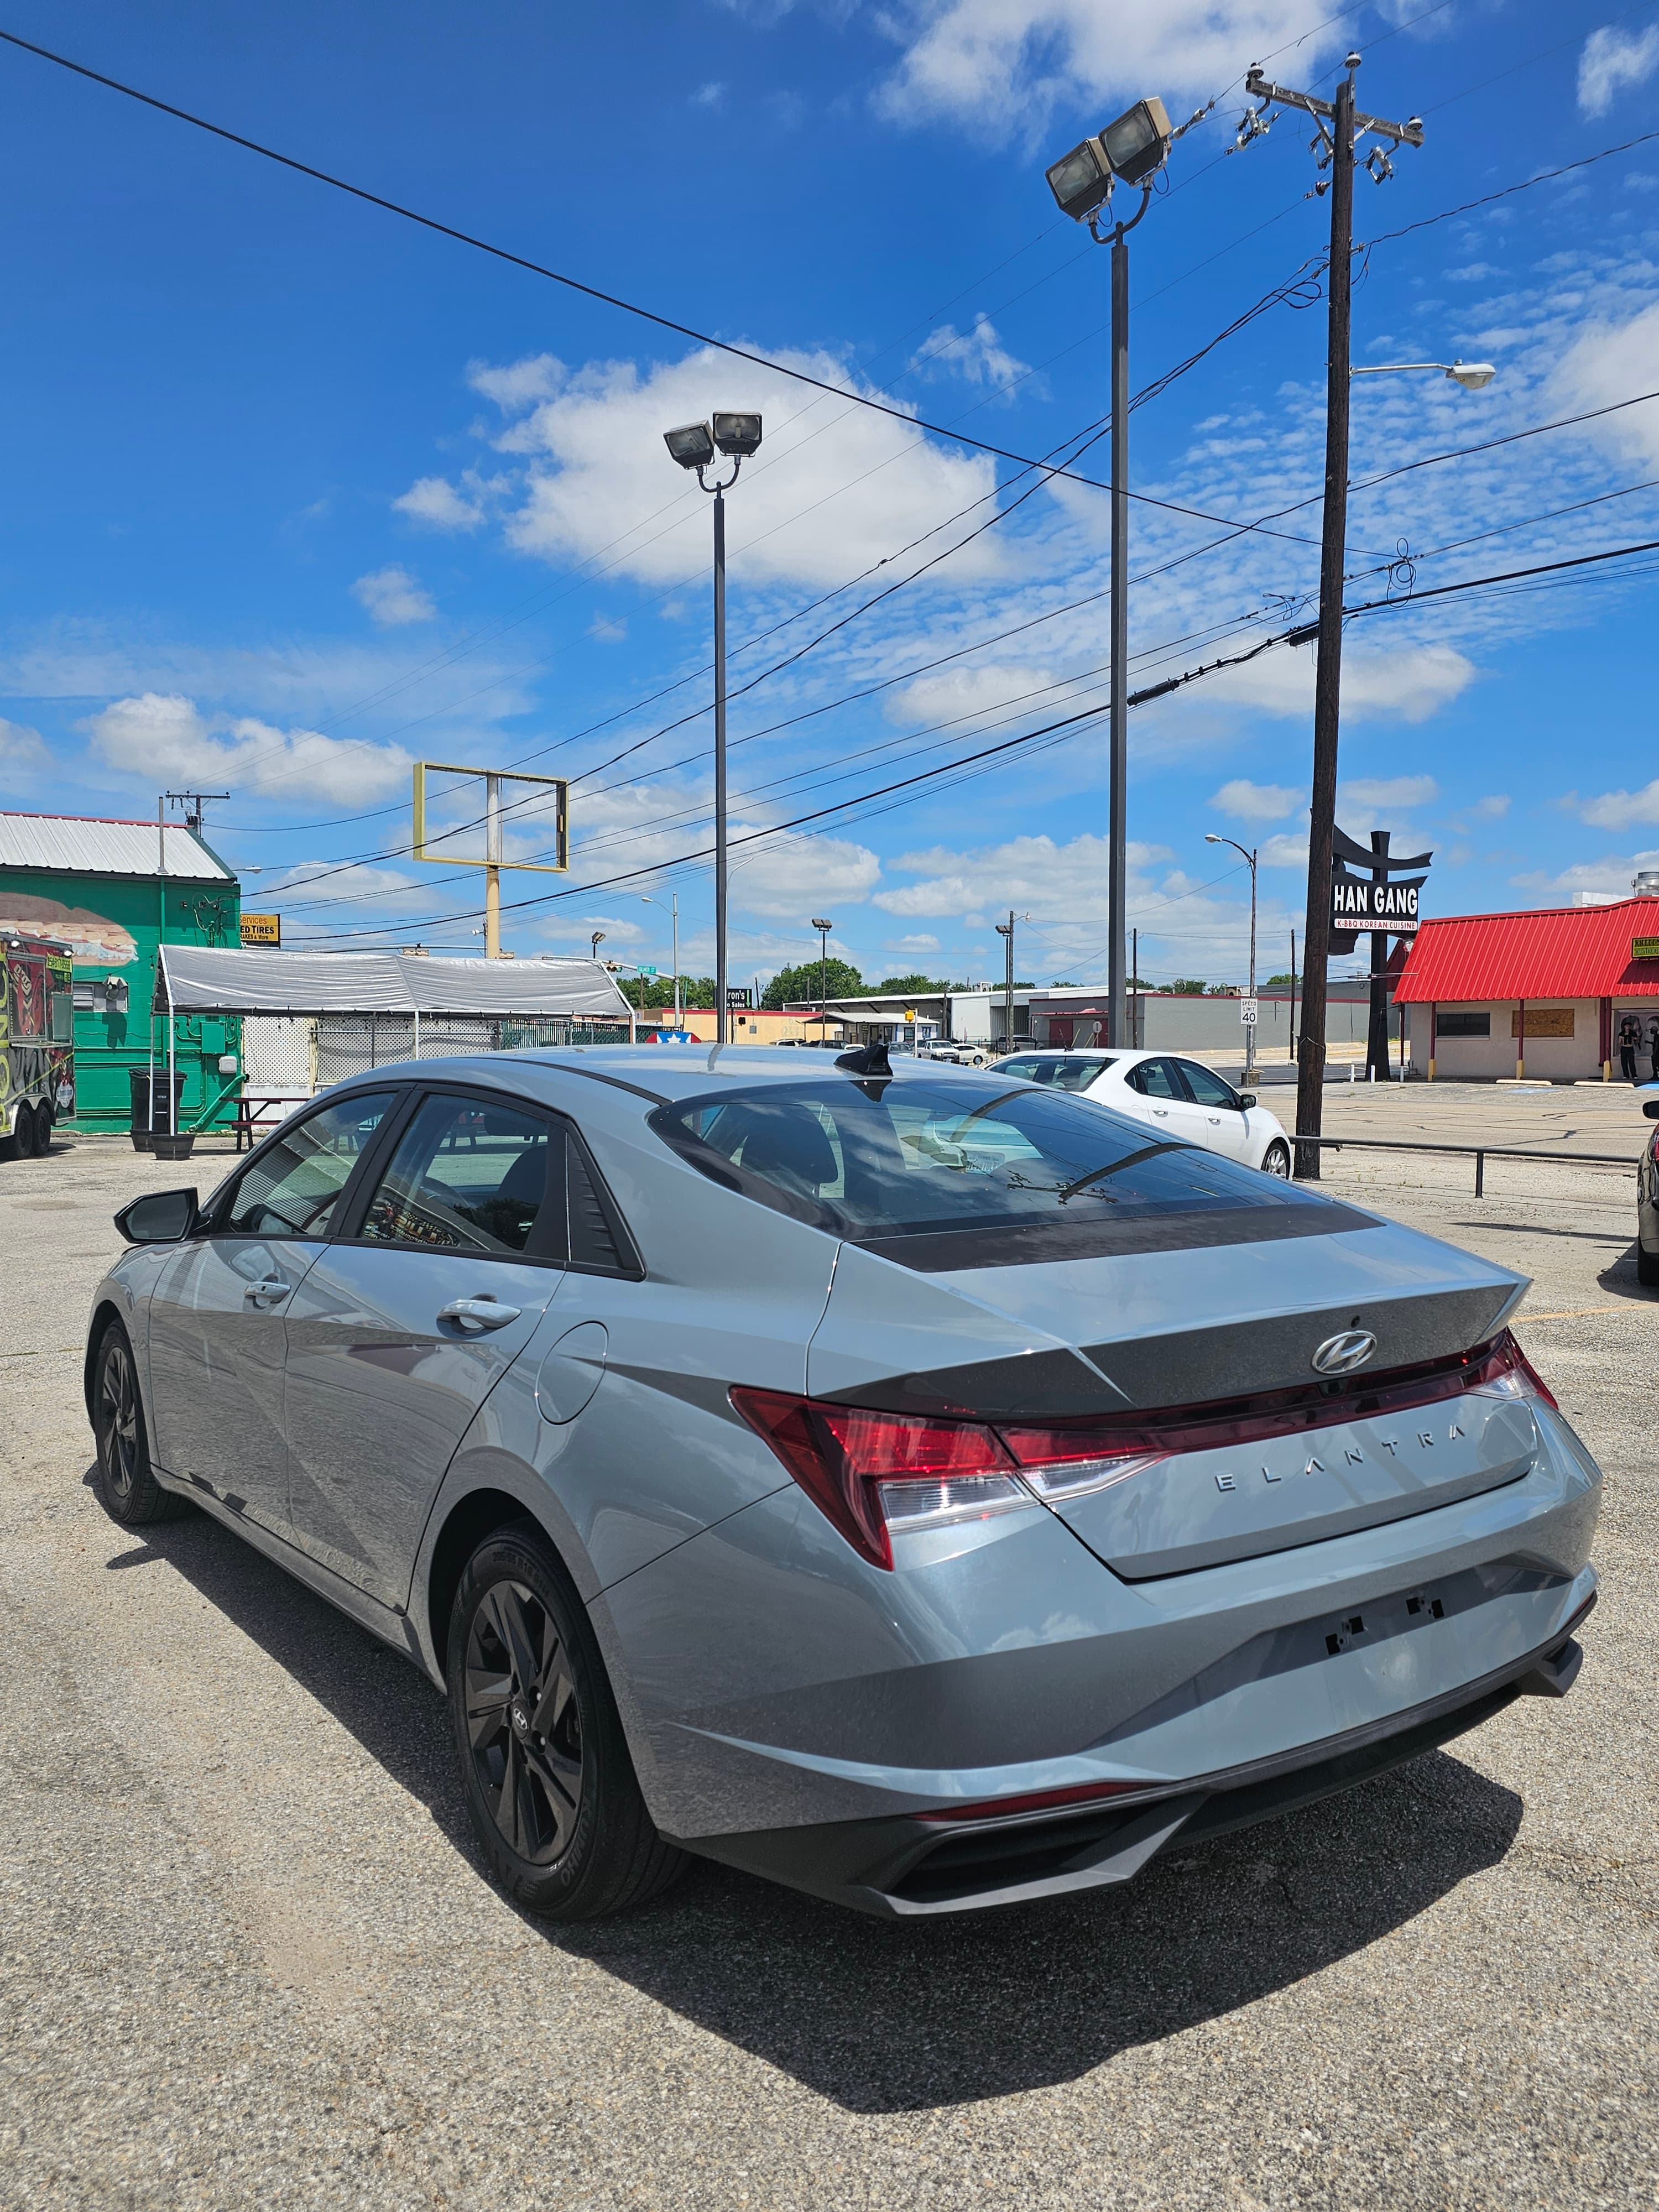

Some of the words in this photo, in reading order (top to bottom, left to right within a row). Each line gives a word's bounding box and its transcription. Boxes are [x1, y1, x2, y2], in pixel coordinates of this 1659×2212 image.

[1334, 885, 1368, 912] HAN
[1374, 886, 1418, 915] GANG
[252, 925, 275, 934] TIRES
[1242, 1013, 1255, 1022] 40
[1215, 1425, 1466, 1492] ELANTRA
